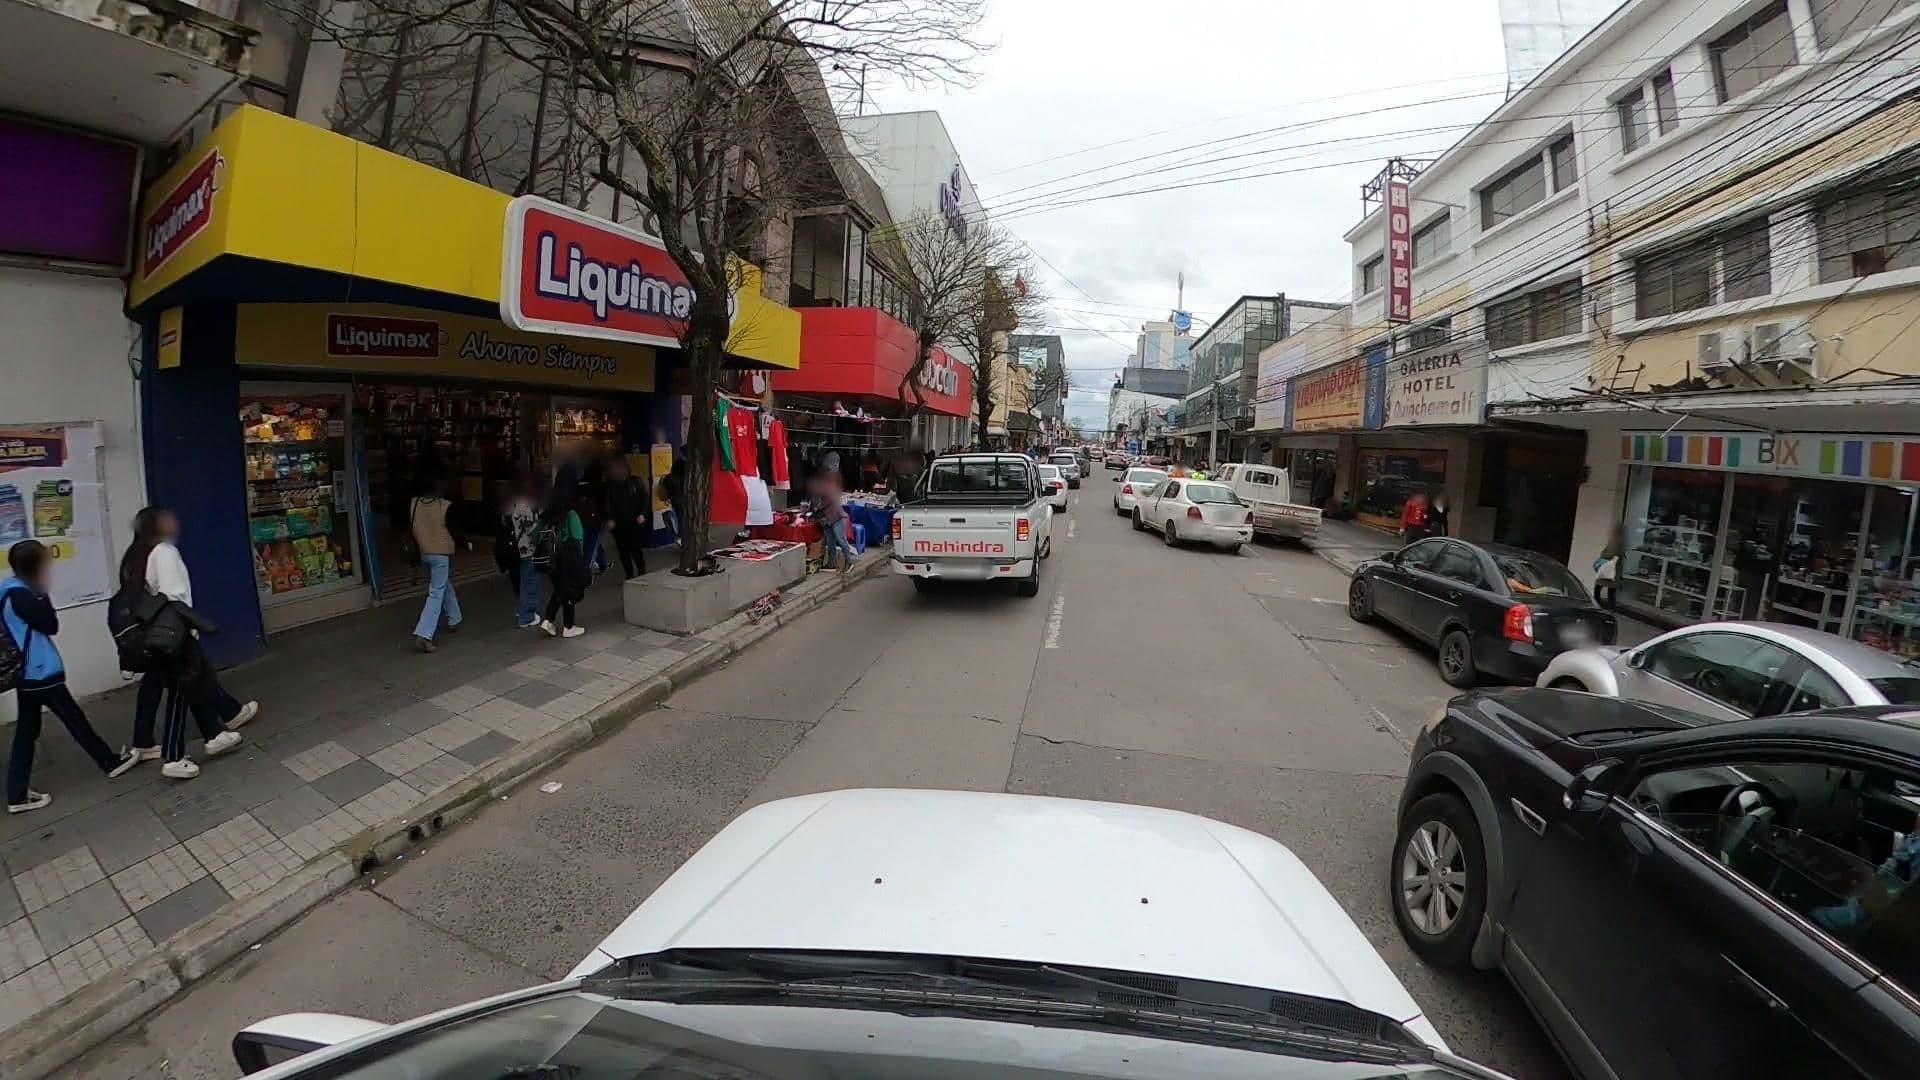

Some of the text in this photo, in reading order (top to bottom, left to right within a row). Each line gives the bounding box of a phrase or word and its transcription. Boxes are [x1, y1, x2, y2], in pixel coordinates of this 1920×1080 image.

[147, 177, 208, 261] Liquimax
[1390, 186, 1409, 316] HOTEL
[336, 323, 431, 352] Liquimax
[459, 331, 617, 380] Ahorro Siempre
[1403, 375, 1455, 395] HOTEL
[1758, 438, 1799, 465] BIX
[914, 540, 1004, 553] Mahindra
